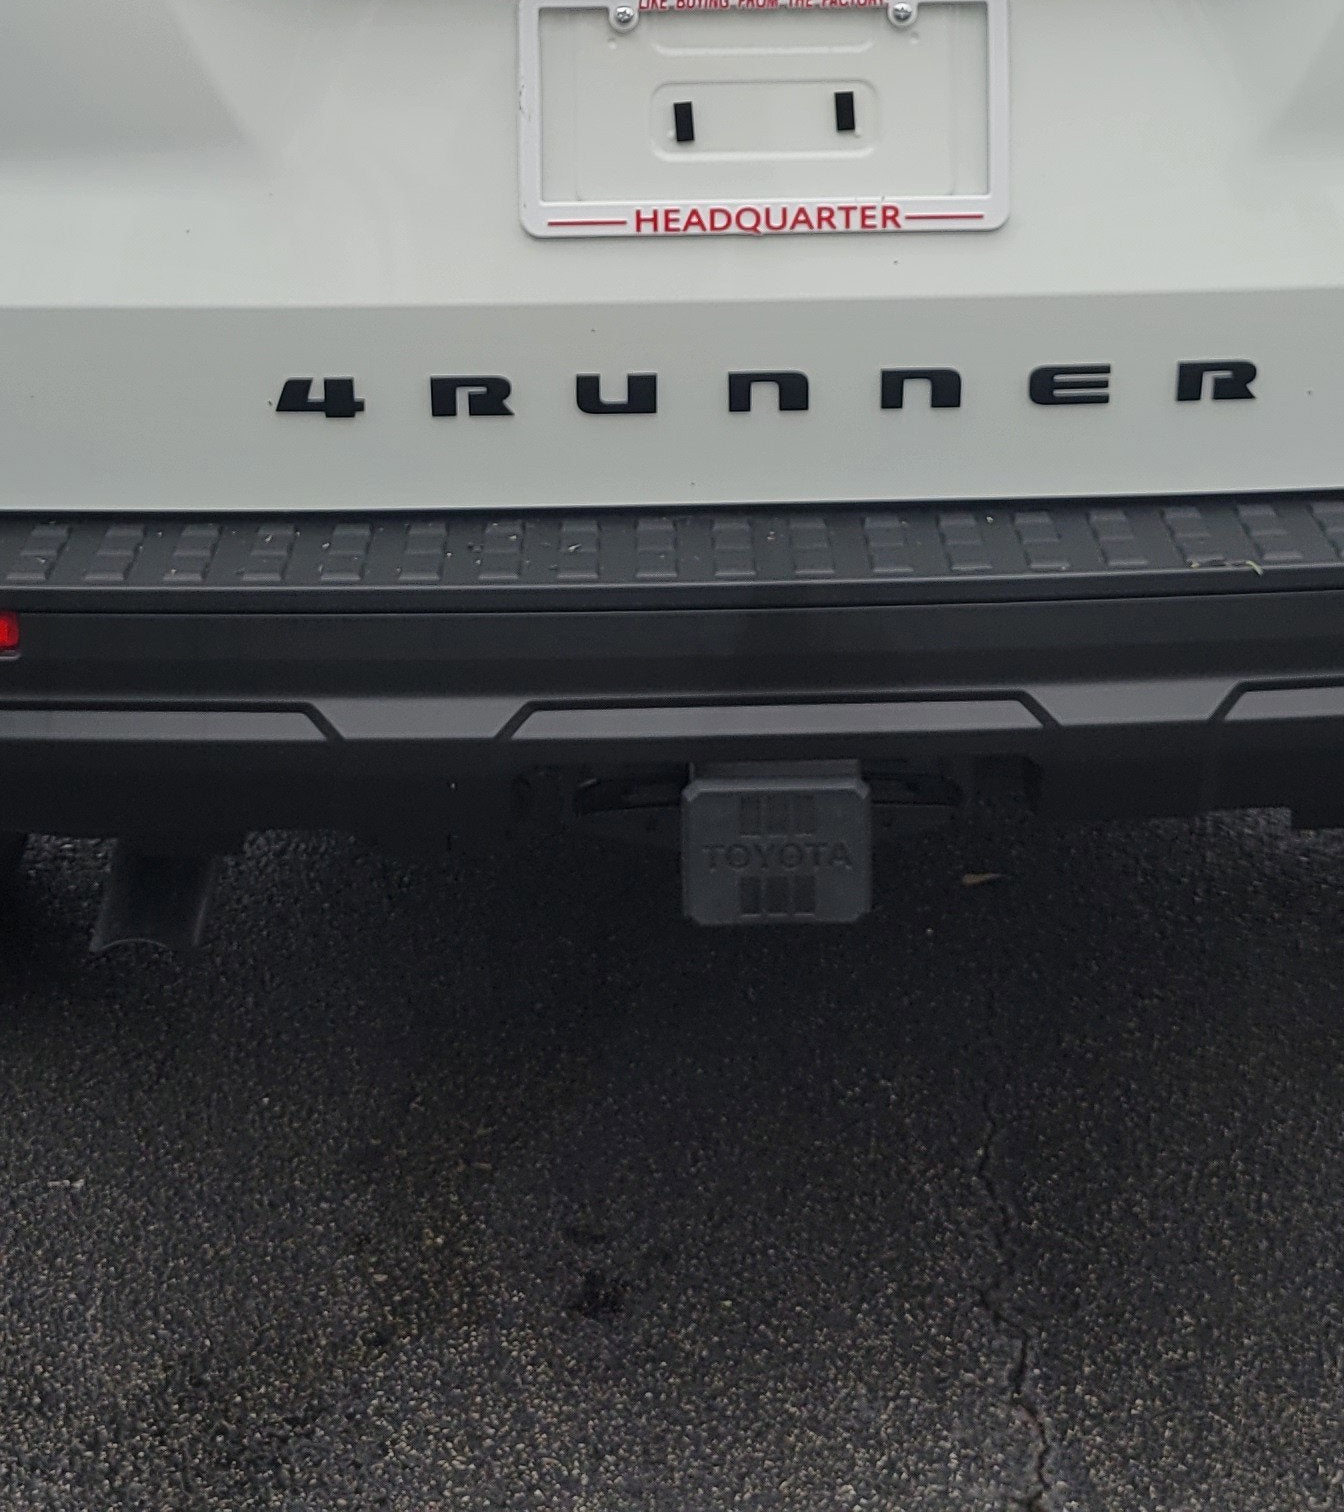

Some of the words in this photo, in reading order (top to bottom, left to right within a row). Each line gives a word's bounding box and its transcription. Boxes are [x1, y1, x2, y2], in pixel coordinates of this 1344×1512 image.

[634, 205, 902, 235] HEADQUARTER
[275, 359, 1258, 417] 4RUNNER
[702, 841, 854, 873] TOYOTA
